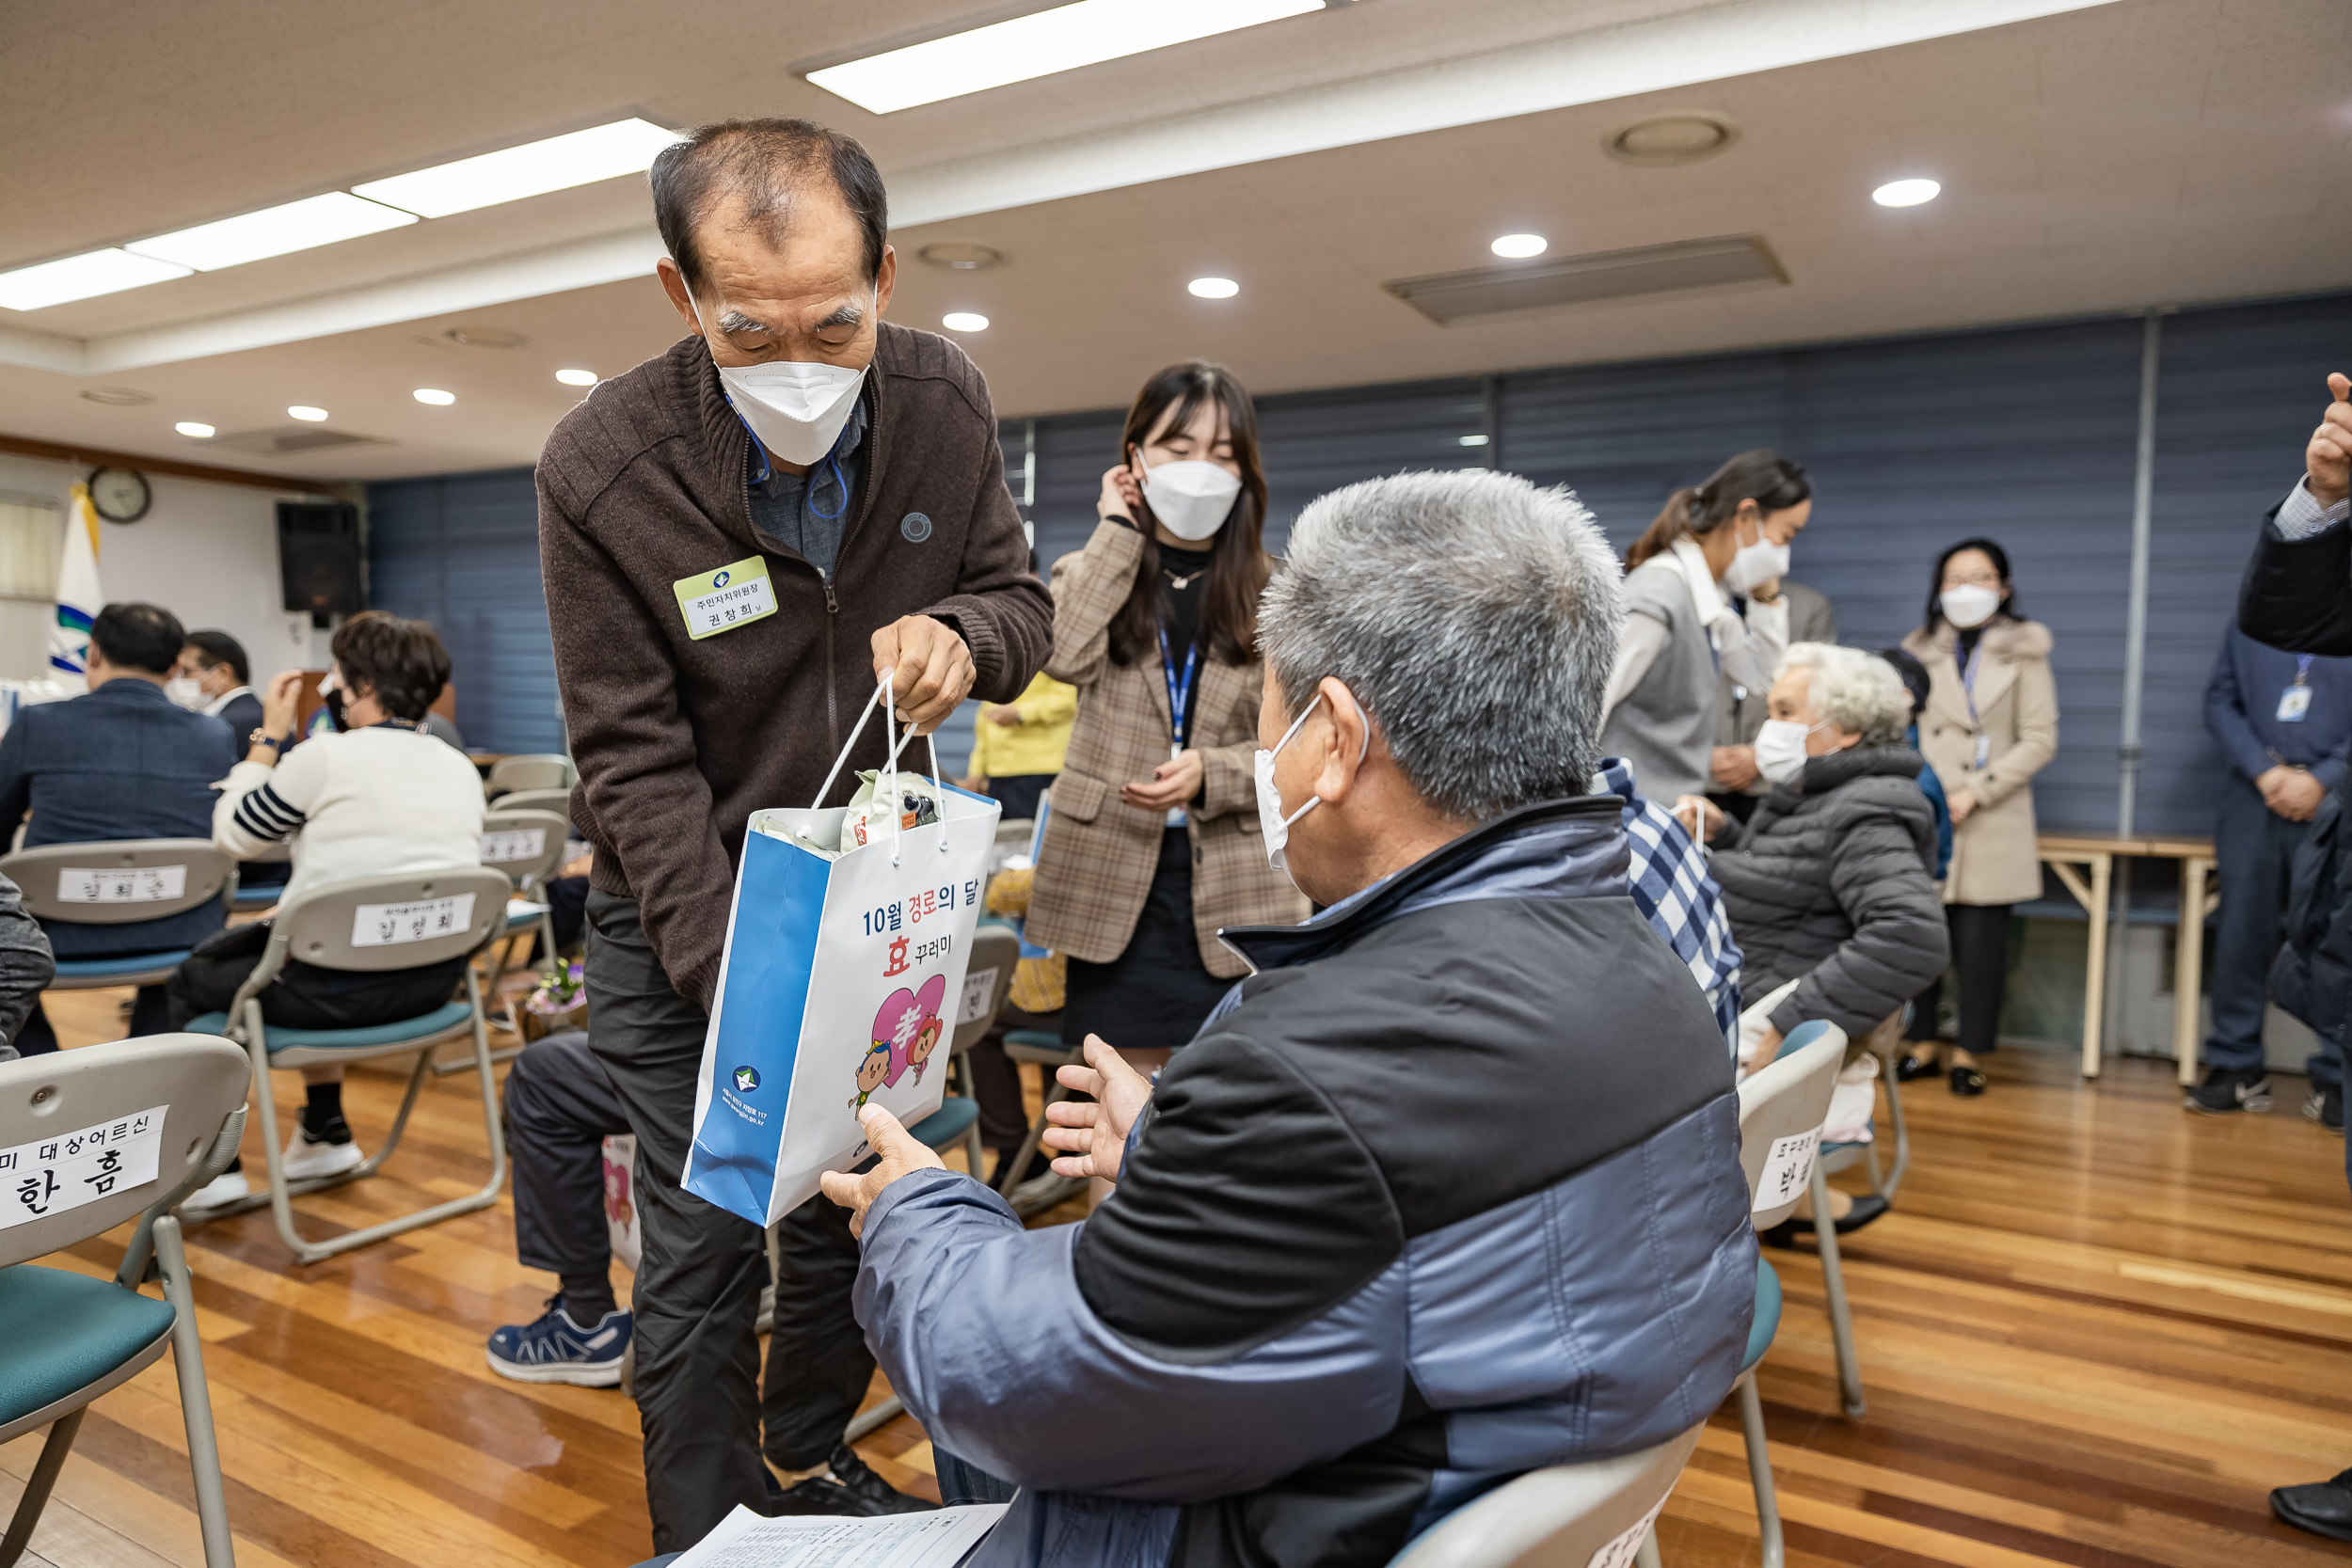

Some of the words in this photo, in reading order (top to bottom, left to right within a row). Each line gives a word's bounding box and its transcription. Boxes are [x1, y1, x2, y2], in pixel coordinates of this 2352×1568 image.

[697, 583, 758, 610] 주민자치위원장
[708, 613, 721, 627] 권
[723, 609, 736, 622] 창
[740, 603, 753, 616] 희
[863, 900, 902, 937] 10월
[909, 884, 955, 924] 경로의
[964, 879, 979, 906] 달
[882, 934, 911, 977] 효
[914, 934, 952, 965] 꾸러미
[892, 1003, 923, 1051] 孝
[757, 1111, 768, 1119] 117
[40, 1116, 149, 1161] 대상어르신
[16, 1169, 60, 1214] 한
[84, 1149, 122, 1195] 흠
